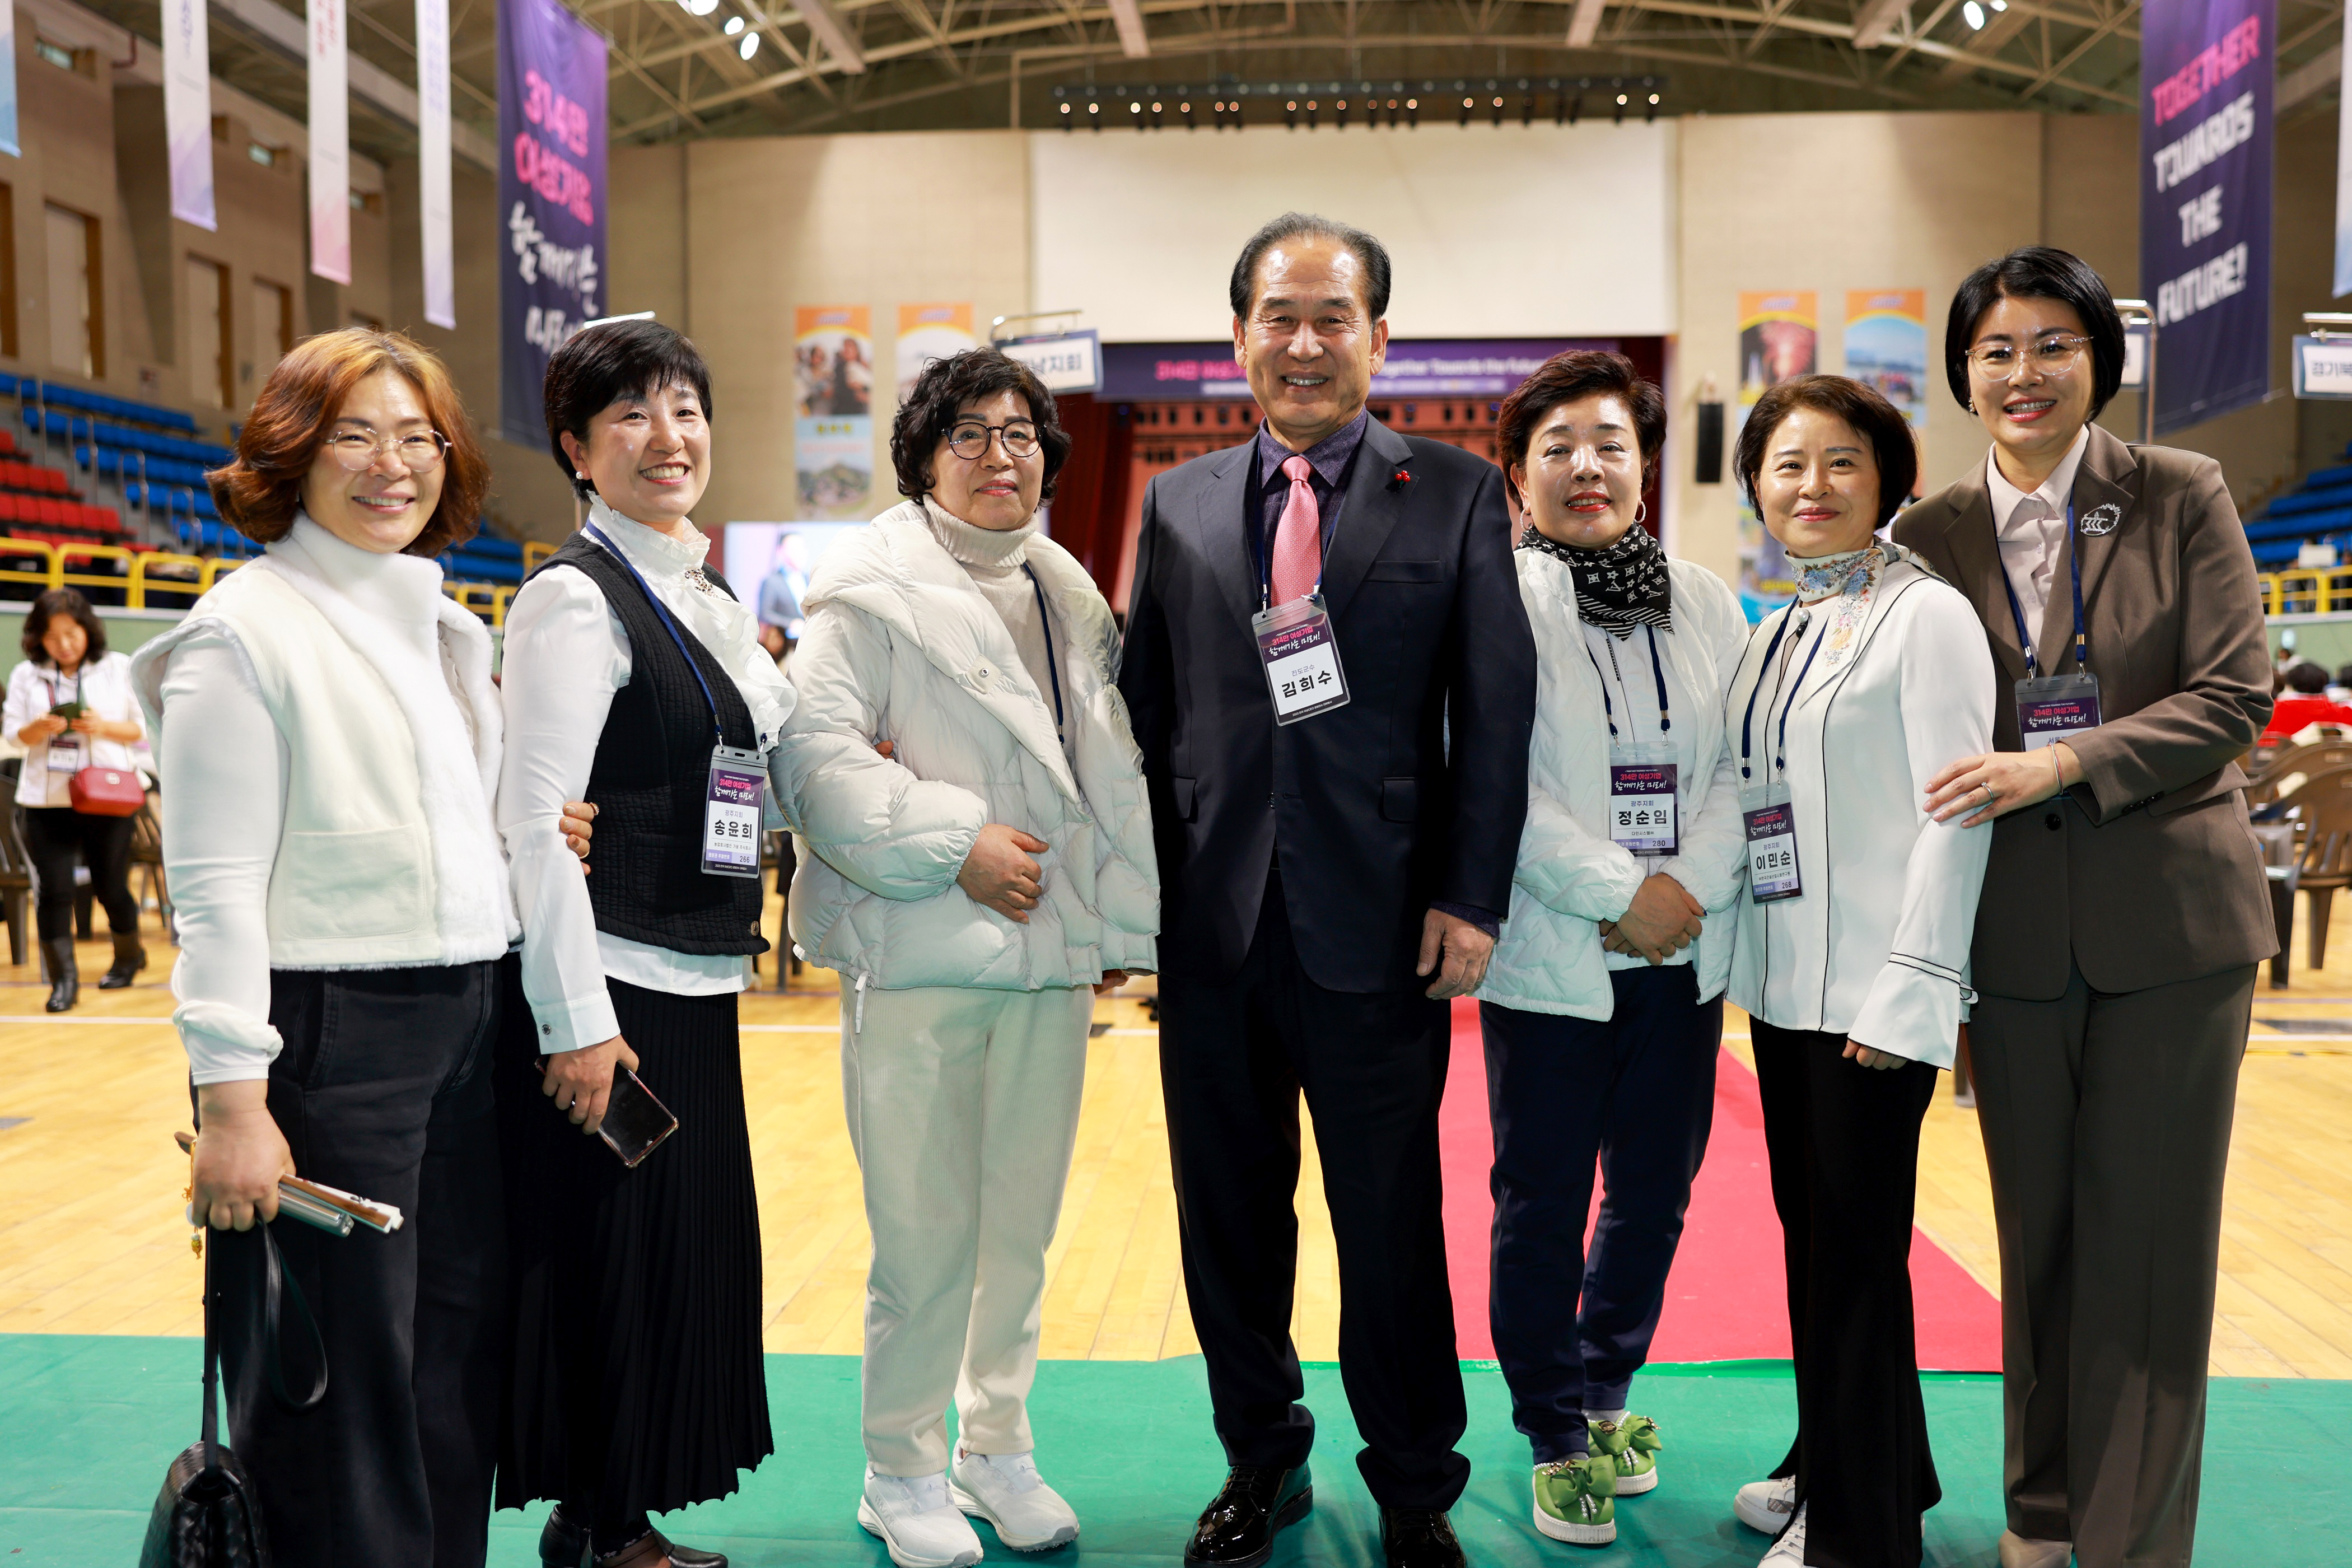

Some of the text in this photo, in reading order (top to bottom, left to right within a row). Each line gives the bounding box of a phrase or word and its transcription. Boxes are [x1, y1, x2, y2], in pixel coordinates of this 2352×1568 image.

[2151, 13, 2261, 127] TOGETHER
[2153, 90, 2255, 193] TOWARDS
[2178, 183, 2223, 248] THE
[2157, 240, 2248, 328] FUTURE!
[1269, 631, 1320, 656] 함께가는 미래!
[1272, 635, 1290, 646] 314만
[1290, 626, 1314, 639] 여성기업
[1291, 664, 1315, 676] 진도군수
[1282, 670, 1332, 698] 김희수
[2054, 706, 2079, 715] 여성기업
[2028, 713, 2087, 728] 함께가는 미래!
[719, 778, 732, 787] 314만
[733, 781, 751, 790] 여성기업
[1615, 780, 1645, 791] 함께가는
[1647, 780, 1667, 788] 미래!
[715, 785, 738, 800] 함께가는
[739, 792, 754, 801] 미래!
[725, 810, 743, 818] 광주지회
[1619, 810, 1667, 825] 정순임
[1753, 816, 1765, 825] 314만
[1766, 813, 1782, 823] 여성기업
[715, 819, 752, 839] 송윤희
[1750, 820, 1786, 836] 함께가는 미래!
[1763, 842, 1780, 851] 광주지회
[1756, 850, 1790, 870] 이민순
